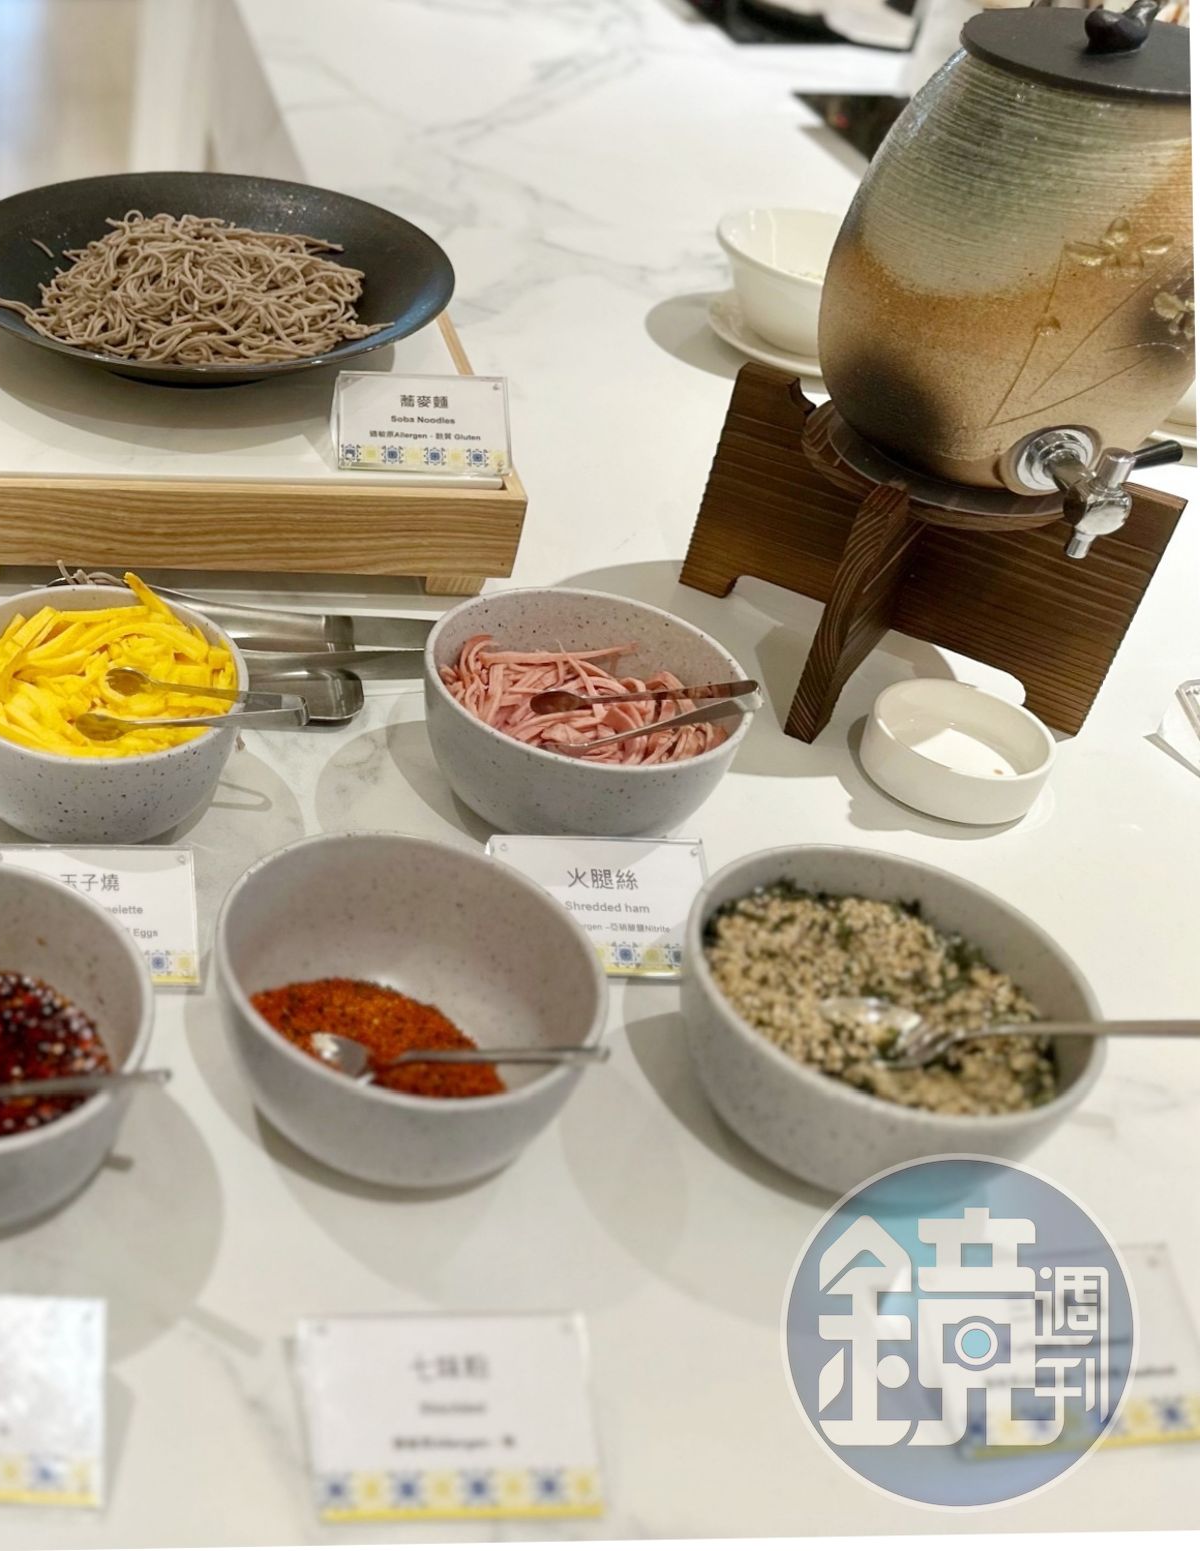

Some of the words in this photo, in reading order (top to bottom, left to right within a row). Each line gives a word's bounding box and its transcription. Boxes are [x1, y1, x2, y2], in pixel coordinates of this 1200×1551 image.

[400, 394, 449, 409] 蕎麥麵
[391, 415, 415, 423] Soba
[417, 416, 456, 425] Noodles
[454, 433, 481, 441] Gluten
[60, 873, 121, 892] 玉子燒
[567, 867, 639, 891] 火腿絲
[565, 900, 622, 913] Shredded
[624, 902, 651, 914] ham
[133, 928, 159, 939] Eggs
